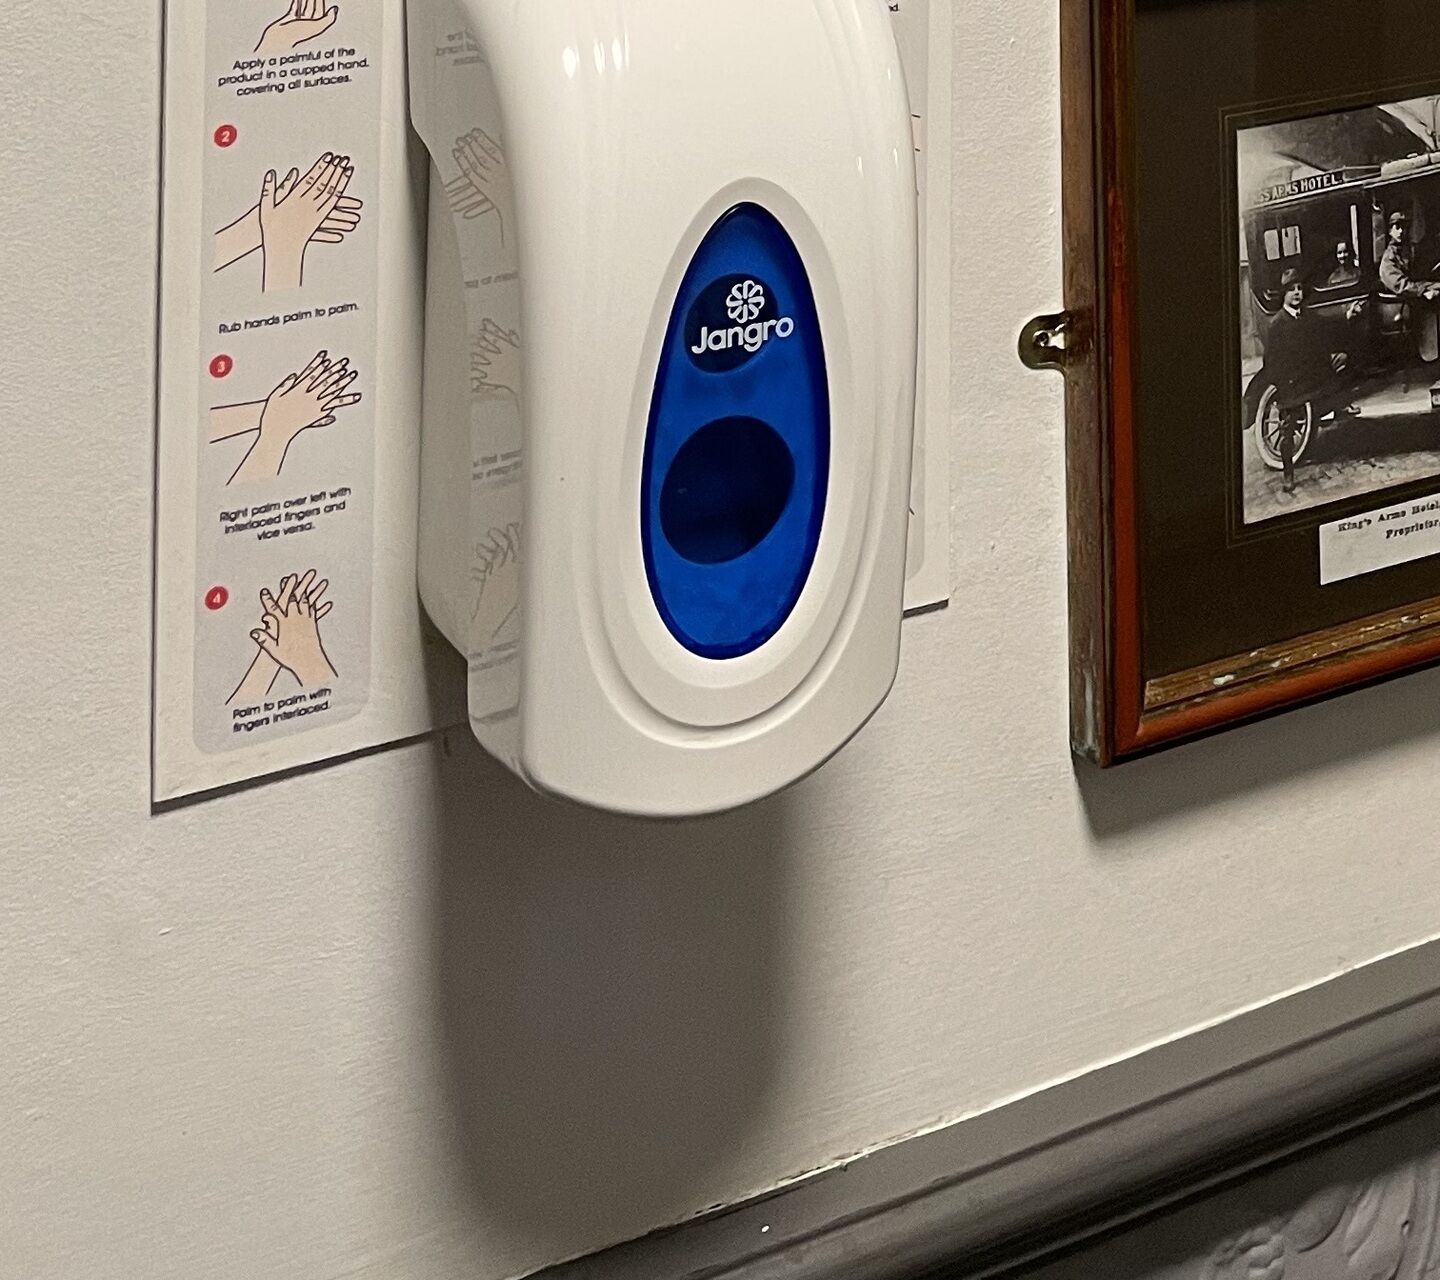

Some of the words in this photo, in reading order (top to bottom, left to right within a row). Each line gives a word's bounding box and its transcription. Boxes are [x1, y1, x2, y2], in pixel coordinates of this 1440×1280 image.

[232, 58, 266, 71] Apply
[268, 57, 277, 66] a
[279, 50, 322, 67] palmful
[324, 48, 335, 59] of
[337, 46, 356, 57] the
[217, 70, 264, 88] product
[266, 69, 277, 79] in
[279, 69, 288, 78] a
[290, 60, 335, 77] cupped
[236, 81, 285, 97] covering
[288, 78, 301, 90] all
[218, 321, 242, 334] Rub
[244, 315, 280, 330] hands
[283, 310, 313, 325] palm
[315, 307, 326, 317] to
[328, 302, 360, 317] palm.
[691, 316, 794, 354] Jangro
[219, 507, 248, 522] Right
[251, 502, 281, 518] palm
[283, 496, 307, 509] over
[310, 491, 327, 504] left
[329, 487, 352, 499] with
[224, 514, 281, 534] interlaced
[284, 507, 321, 521] fingers
[323, 500, 346, 513] and
[1377, 509, 1407, 523] Arms
[257, 529, 280, 541] vice
[232, 706, 261, 720] Palm
[263, 702, 275, 712] to
[277, 694, 307, 710] palm
[309, 687, 332, 700] with
[232, 716, 270, 733] fingers
